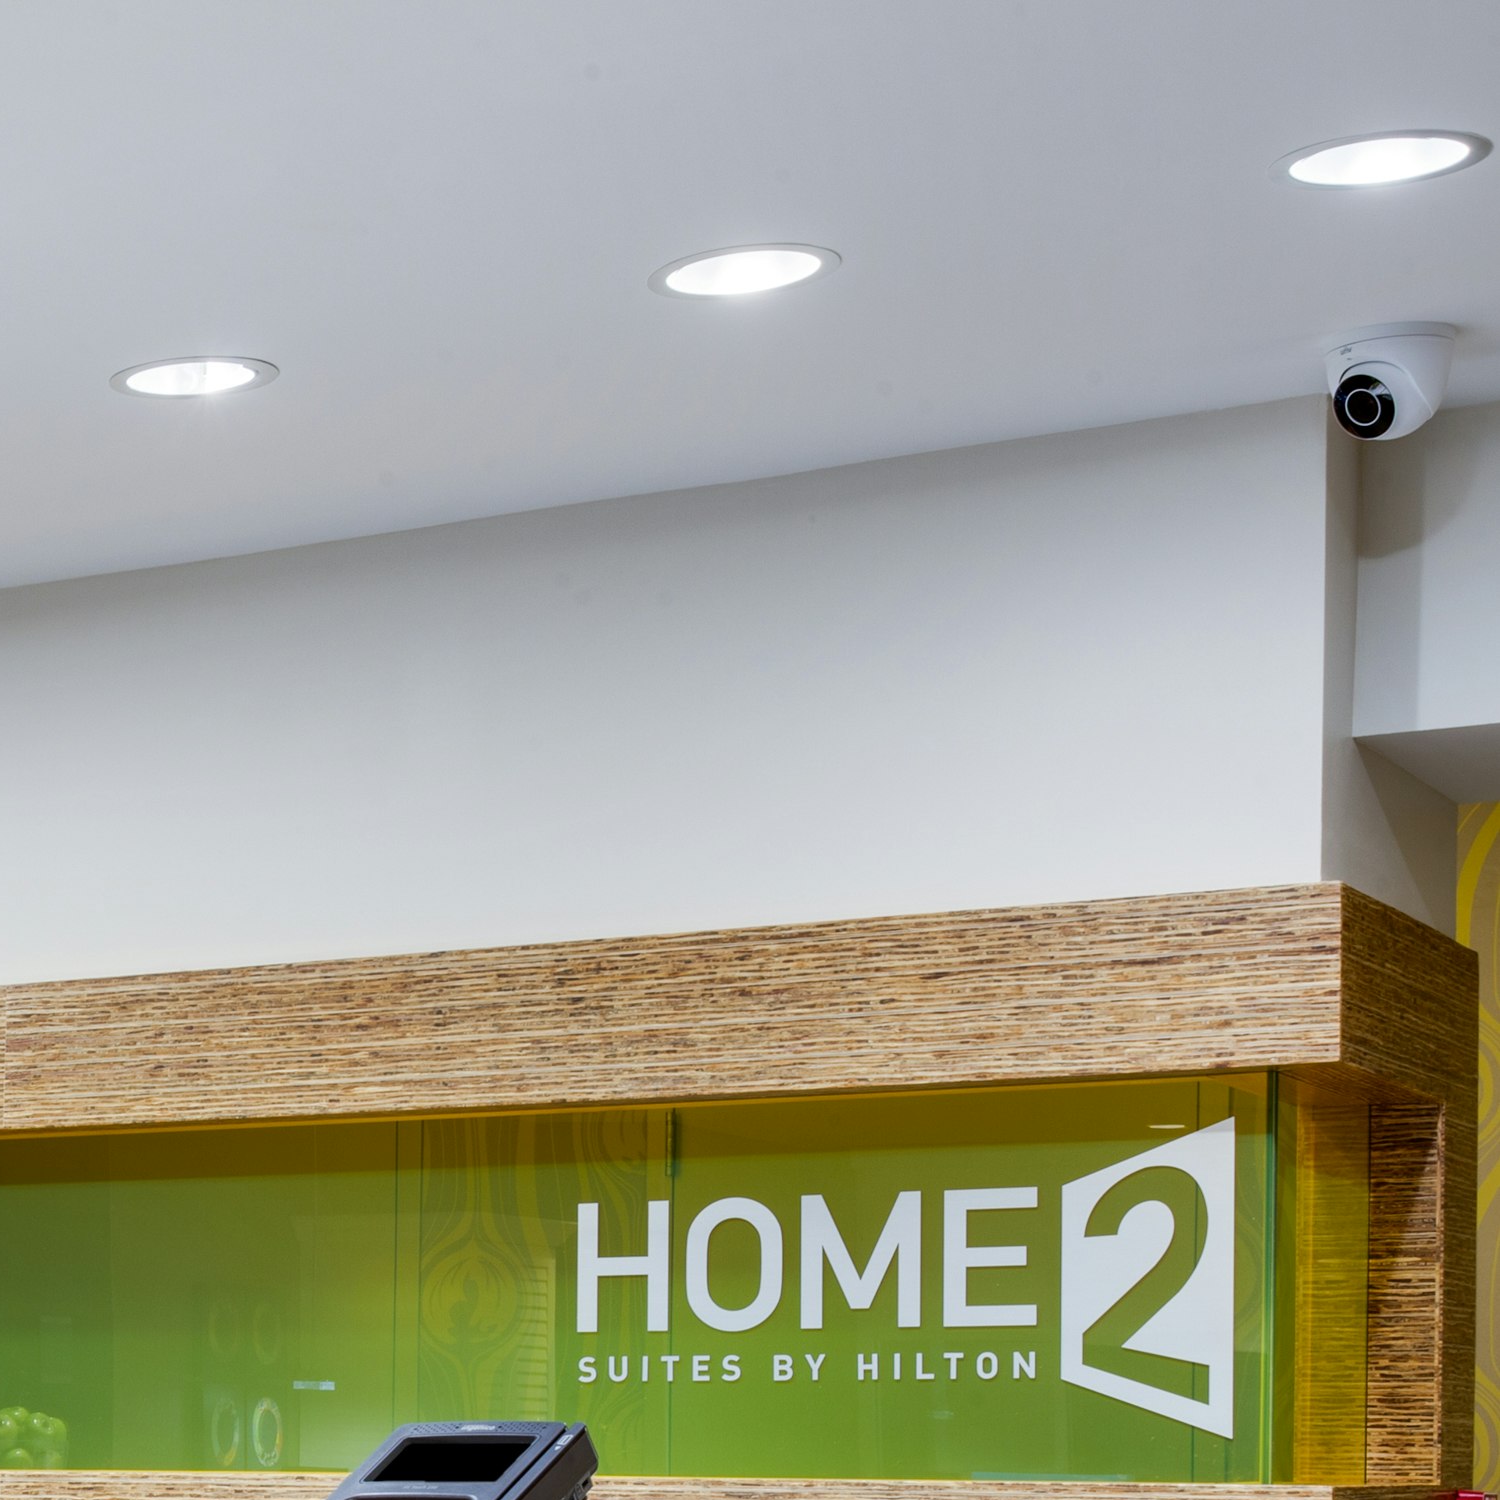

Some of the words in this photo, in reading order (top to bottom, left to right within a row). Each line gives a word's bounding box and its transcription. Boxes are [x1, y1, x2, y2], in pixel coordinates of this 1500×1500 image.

[576, 1186, 1039, 1333] HOME
[577, 1353, 743, 1384] SUITES
[772, 1353, 826, 1383] BY
[856, 1351, 1037, 1382] HILTON
